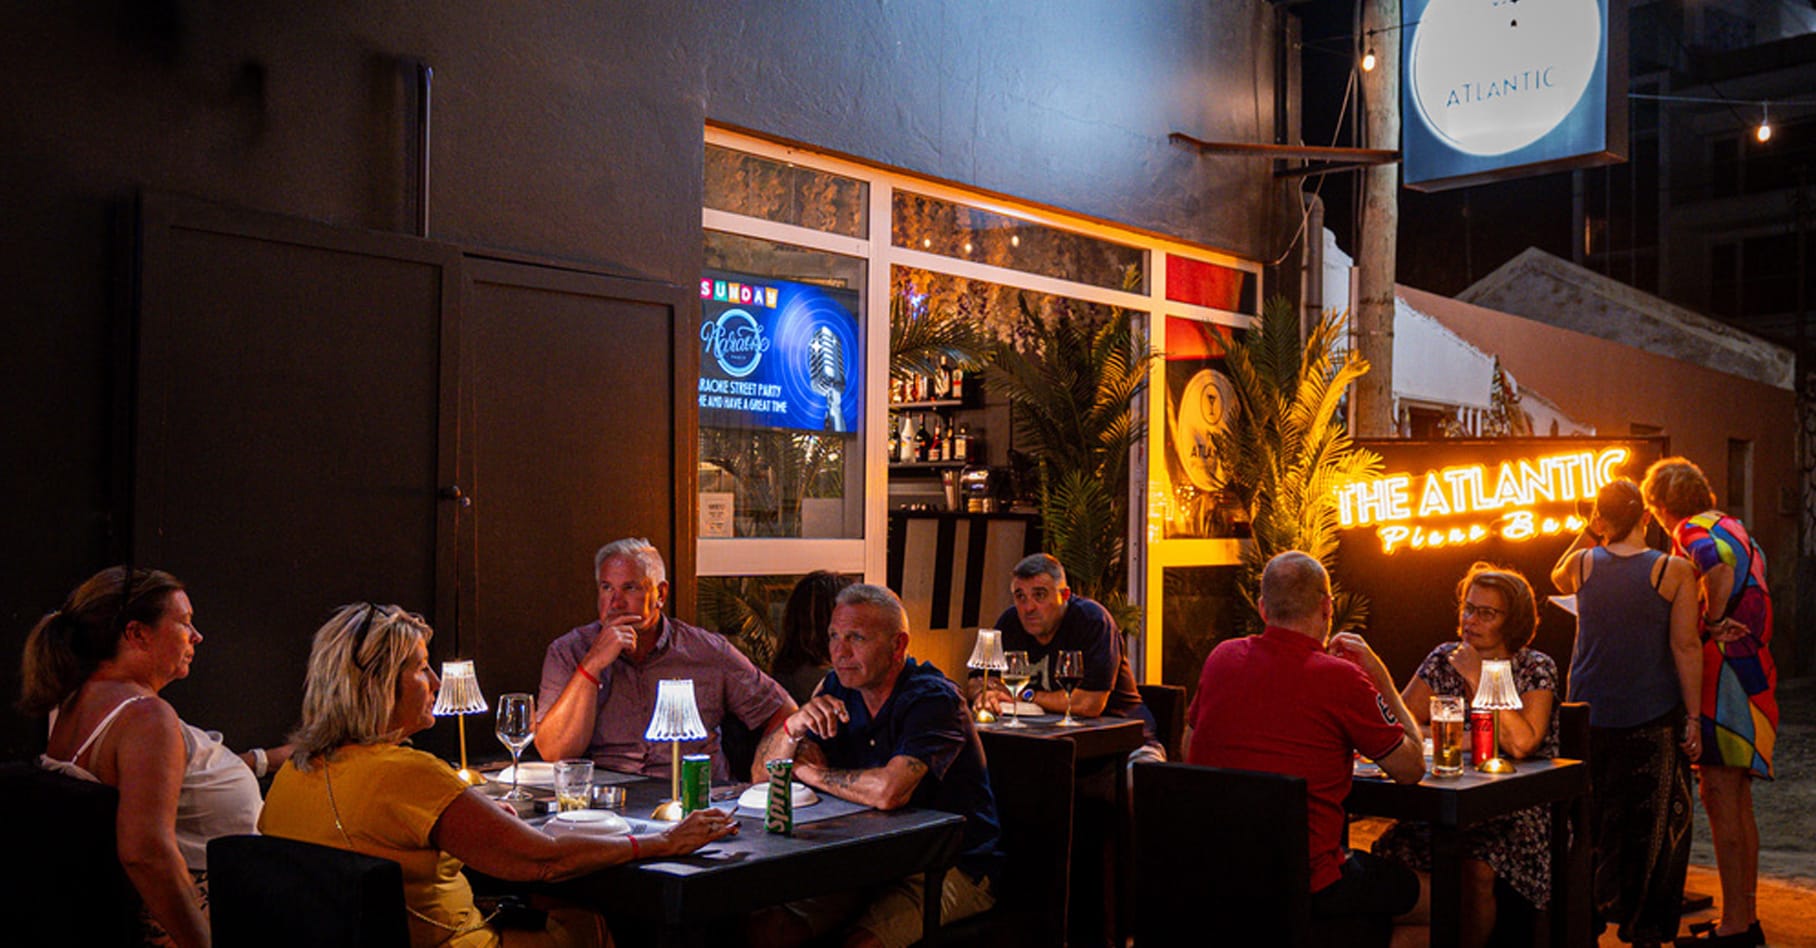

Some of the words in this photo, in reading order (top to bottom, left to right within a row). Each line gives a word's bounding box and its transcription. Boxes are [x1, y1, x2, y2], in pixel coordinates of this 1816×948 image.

[1446, 66, 1556, 108] ATLANTIC
[701, 281, 777, 305] SUNDAY
[708, 395, 722, 408] AND
[724, 396, 743, 410] HAVE
[743, 397, 749, 410] A
[749, 398, 771, 412] GREAT
[771, 400, 788, 414] TIME
[730, 381, 757, 396] STREET
[758, 383, 782, 398] PARTY
[1336, 475, 1411, 526] THE
[1418, 448, 1626, 518] ATLANTIC
[1379, 523, 1486, 554] Piano
[1501, 510, 1586, 539] Bar
